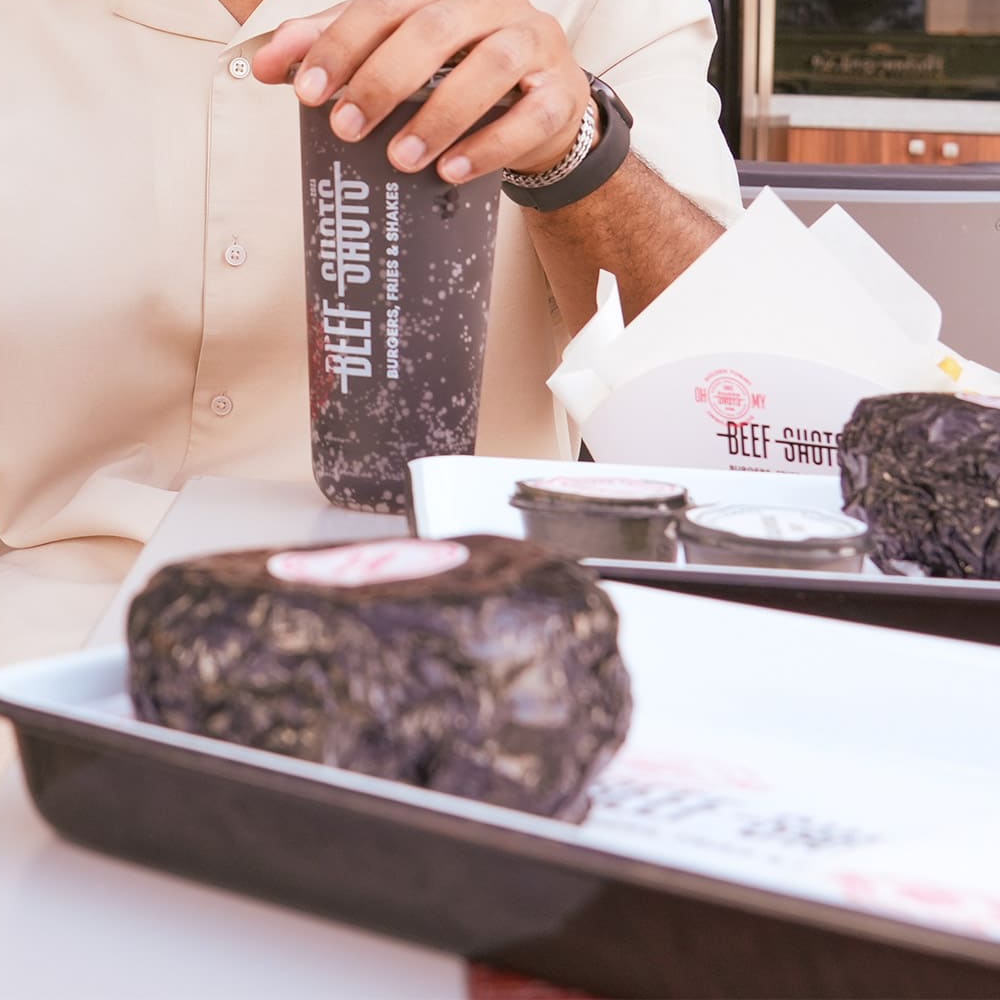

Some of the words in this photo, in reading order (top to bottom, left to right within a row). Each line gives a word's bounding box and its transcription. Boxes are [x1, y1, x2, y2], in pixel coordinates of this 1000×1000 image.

[317, 161, 372, 297] SHOTS
[384, 181, 400, 242] SHAKES
[385, 259, 400, 301] FRIES
[386, 244, 400, 257] &
[322, 299, 373, 394] BEEF
[385, 305, 400, 380] BURGERS,
[716, 421, 770, 459] BEEF
